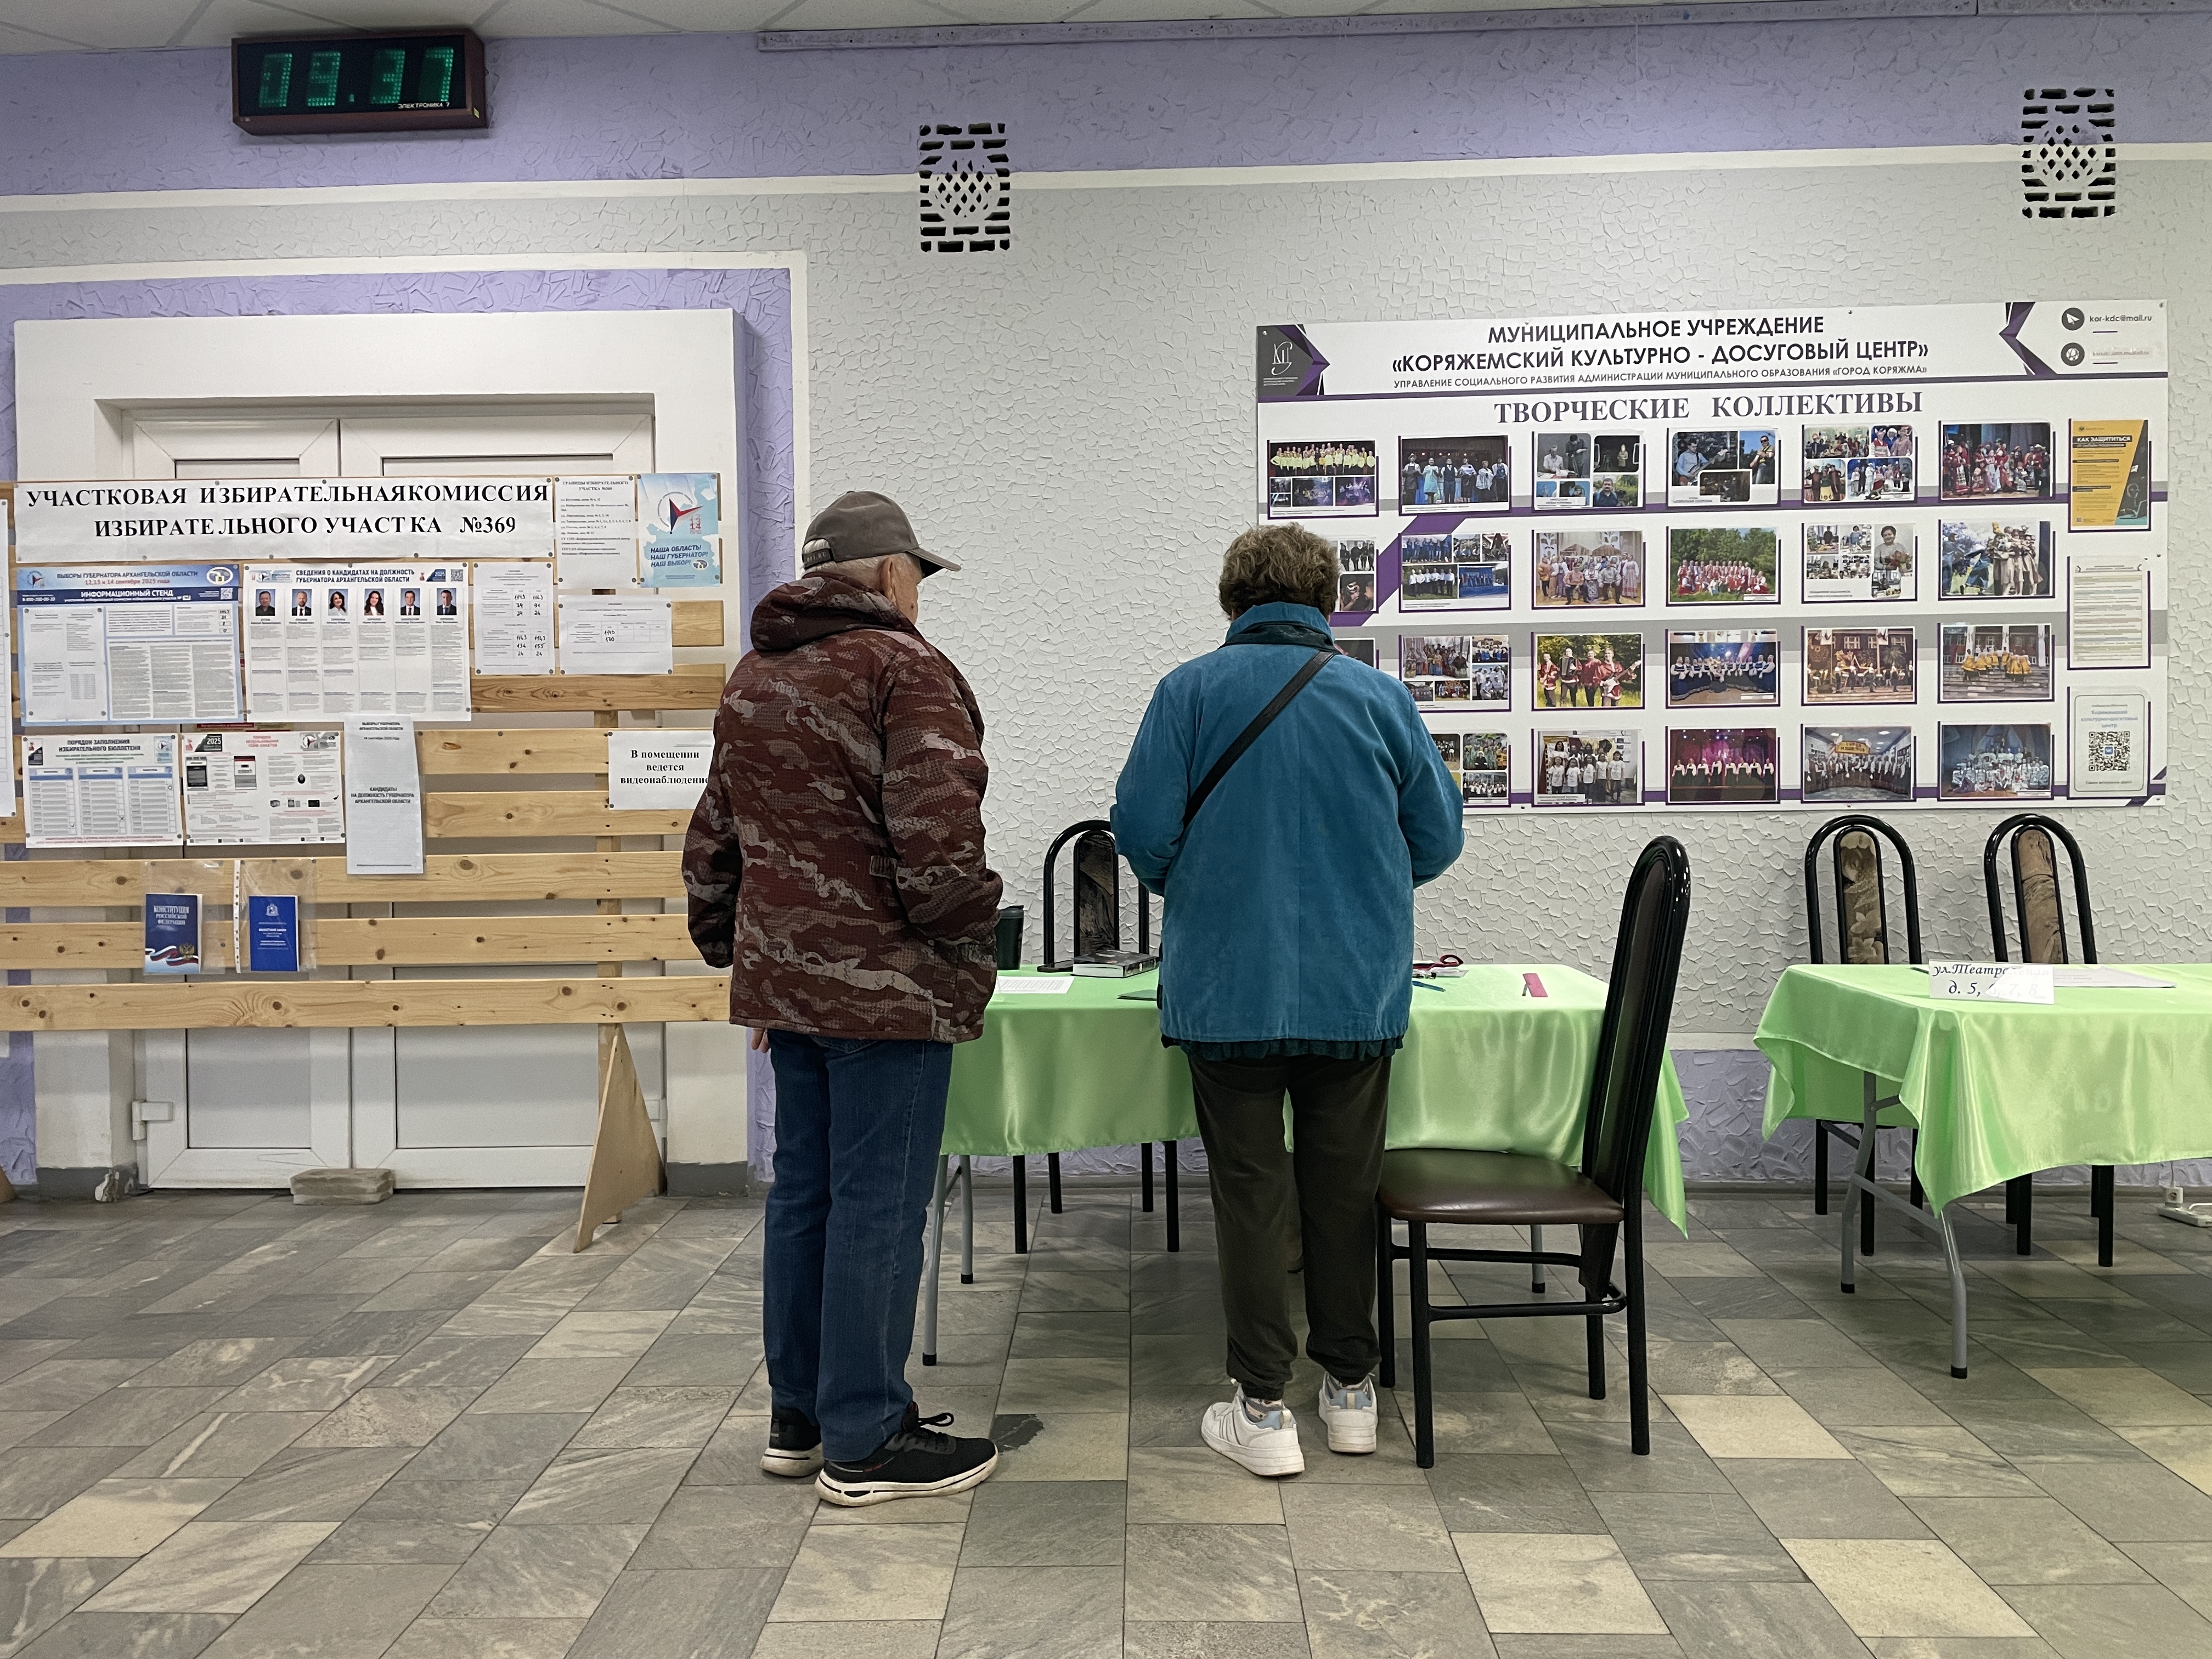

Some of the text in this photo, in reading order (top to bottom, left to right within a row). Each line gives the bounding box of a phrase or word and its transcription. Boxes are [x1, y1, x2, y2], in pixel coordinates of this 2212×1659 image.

[2089, 314, 2152, 323] kor-kdc@mail.ru
[1488, 316, 1824, 343] МУНИЦИПАЛЬНОЕ УЧРЕЖДЕНИЕ
[1392, 347, 1564, 372] «КОРЯЖЕМСКИЙ
[1571, 347, 1690, 366] КУЛЬТУРНО
[1712, 338, 1848, 364] ДОСУГОВЫЙ
[1857, 341, 1929, 360] ЦЕНТР»
[1393, 365, 1927, 388] УПРАВЛЕНИЕ СОЦИАЛЬНОГО РАЗВИТИЯ АДМИНИСТРАЦИИ МУНИЦИПАЛЬНОГО ОБРАЗОВАНИЯ «ГОРОД КОРЯЖМА»
[1494, 392, 1923, 424] ТВОРЧЕСКИЕ КОЛЛЕКТИВЫ
[26, 487, 187, 507] УЧАСТКОВАЯ
[94, 516, 516, 537] ИЗБИРАТЕЛЬНОГО УЧАСТКА №369
[667, 551, 708, 560] ГУБЕРНАТОР!
[81, 589, 150, 597] ИНФОРМАЦИОННЫЙ
[631, 750, 638, 758] В
[1948, 980, 1961, 994] д.
[1967, 982, 1981, 997] 5,
